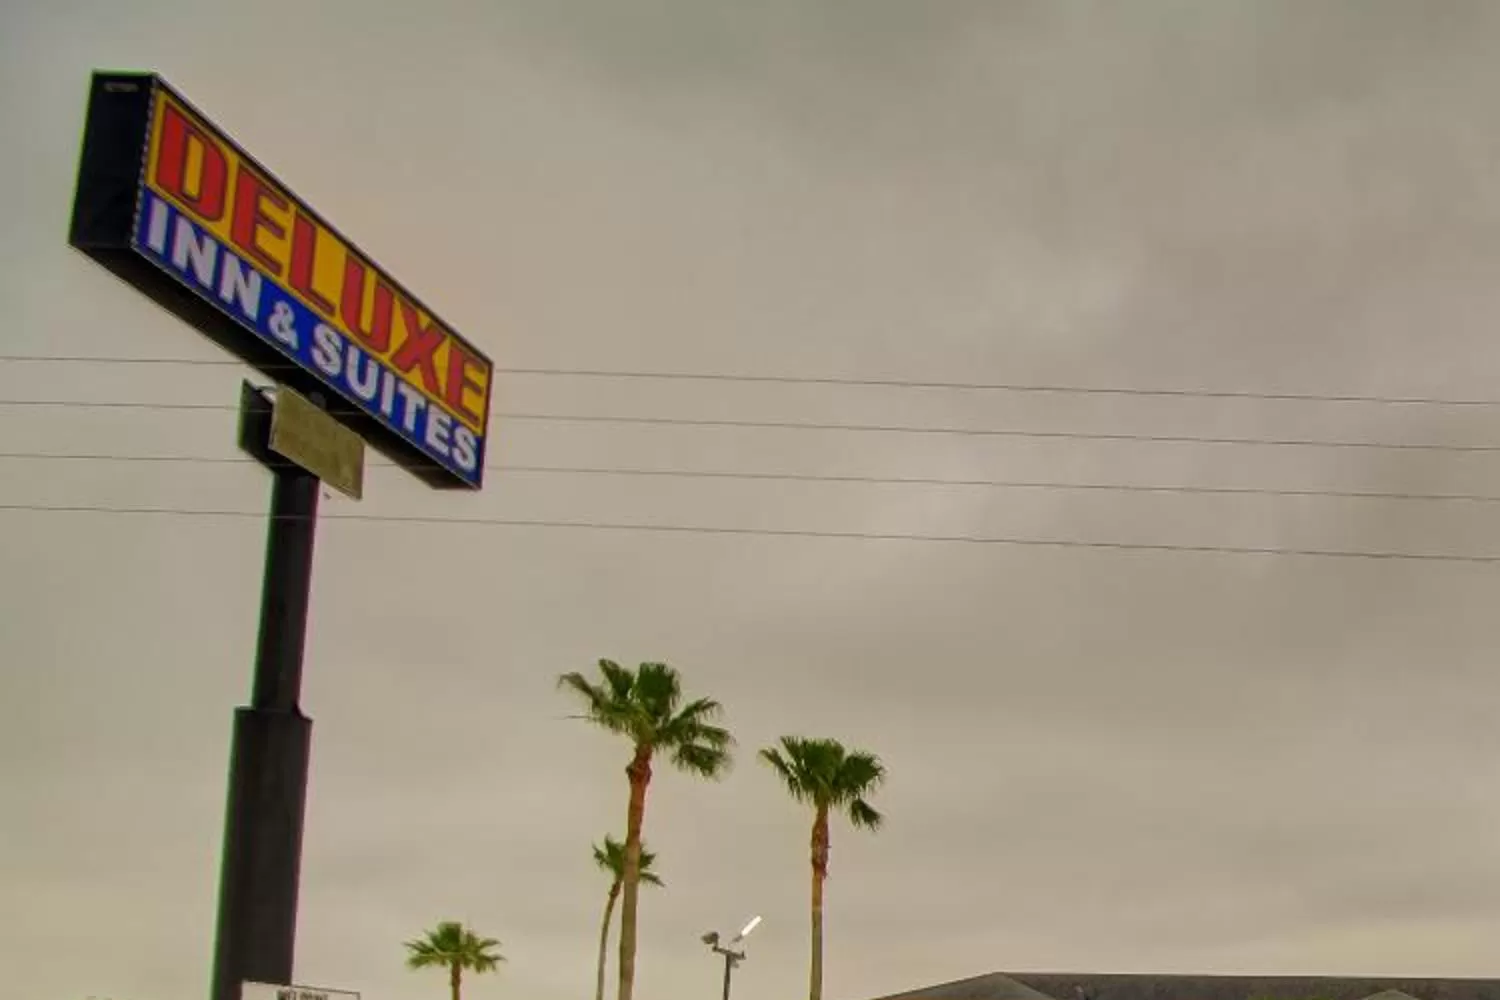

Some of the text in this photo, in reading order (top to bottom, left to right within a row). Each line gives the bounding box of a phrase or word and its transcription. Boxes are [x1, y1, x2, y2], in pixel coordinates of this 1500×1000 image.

[145, 197, 477, 472] INN & SUITES
[154, 101, 485, 427] DELUXE
